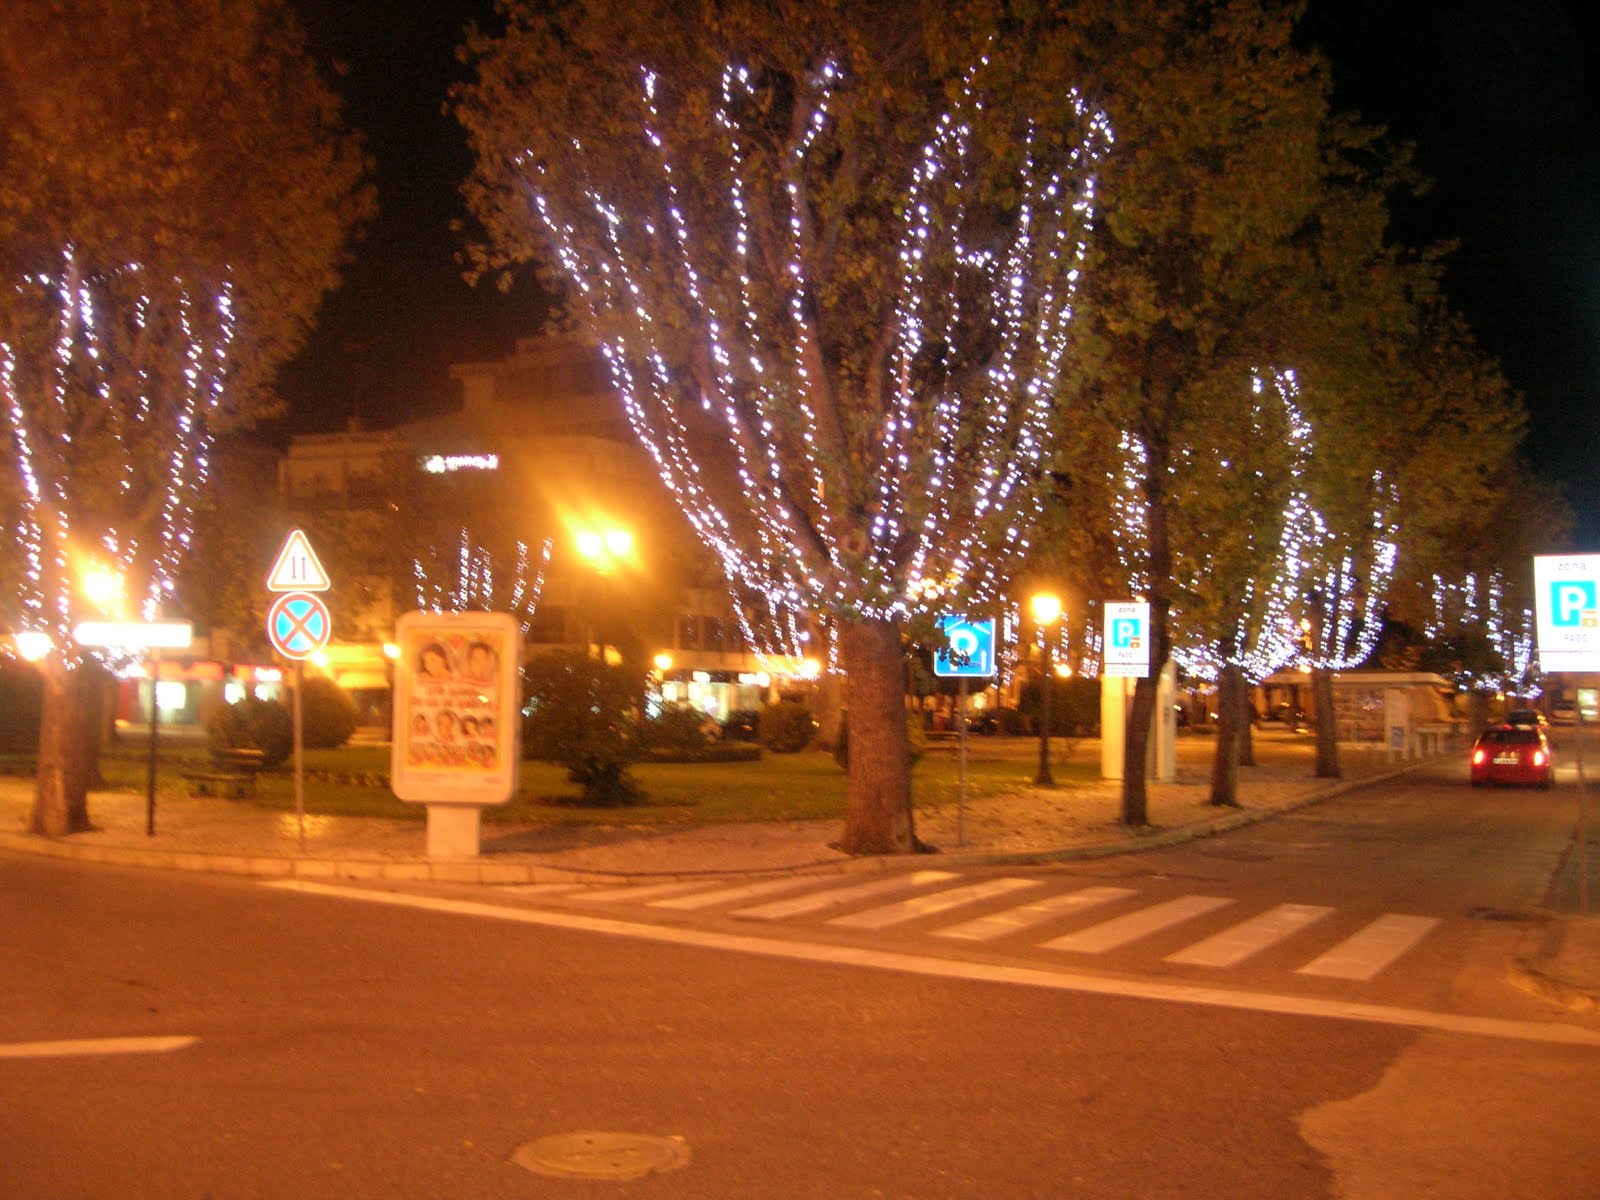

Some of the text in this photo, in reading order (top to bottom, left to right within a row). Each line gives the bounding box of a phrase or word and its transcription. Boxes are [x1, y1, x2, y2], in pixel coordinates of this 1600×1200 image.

[1558, 562, 1587, 571] zona
[1560, 586, 1588, 621] P
[1118, 623, 1134, 645] P
